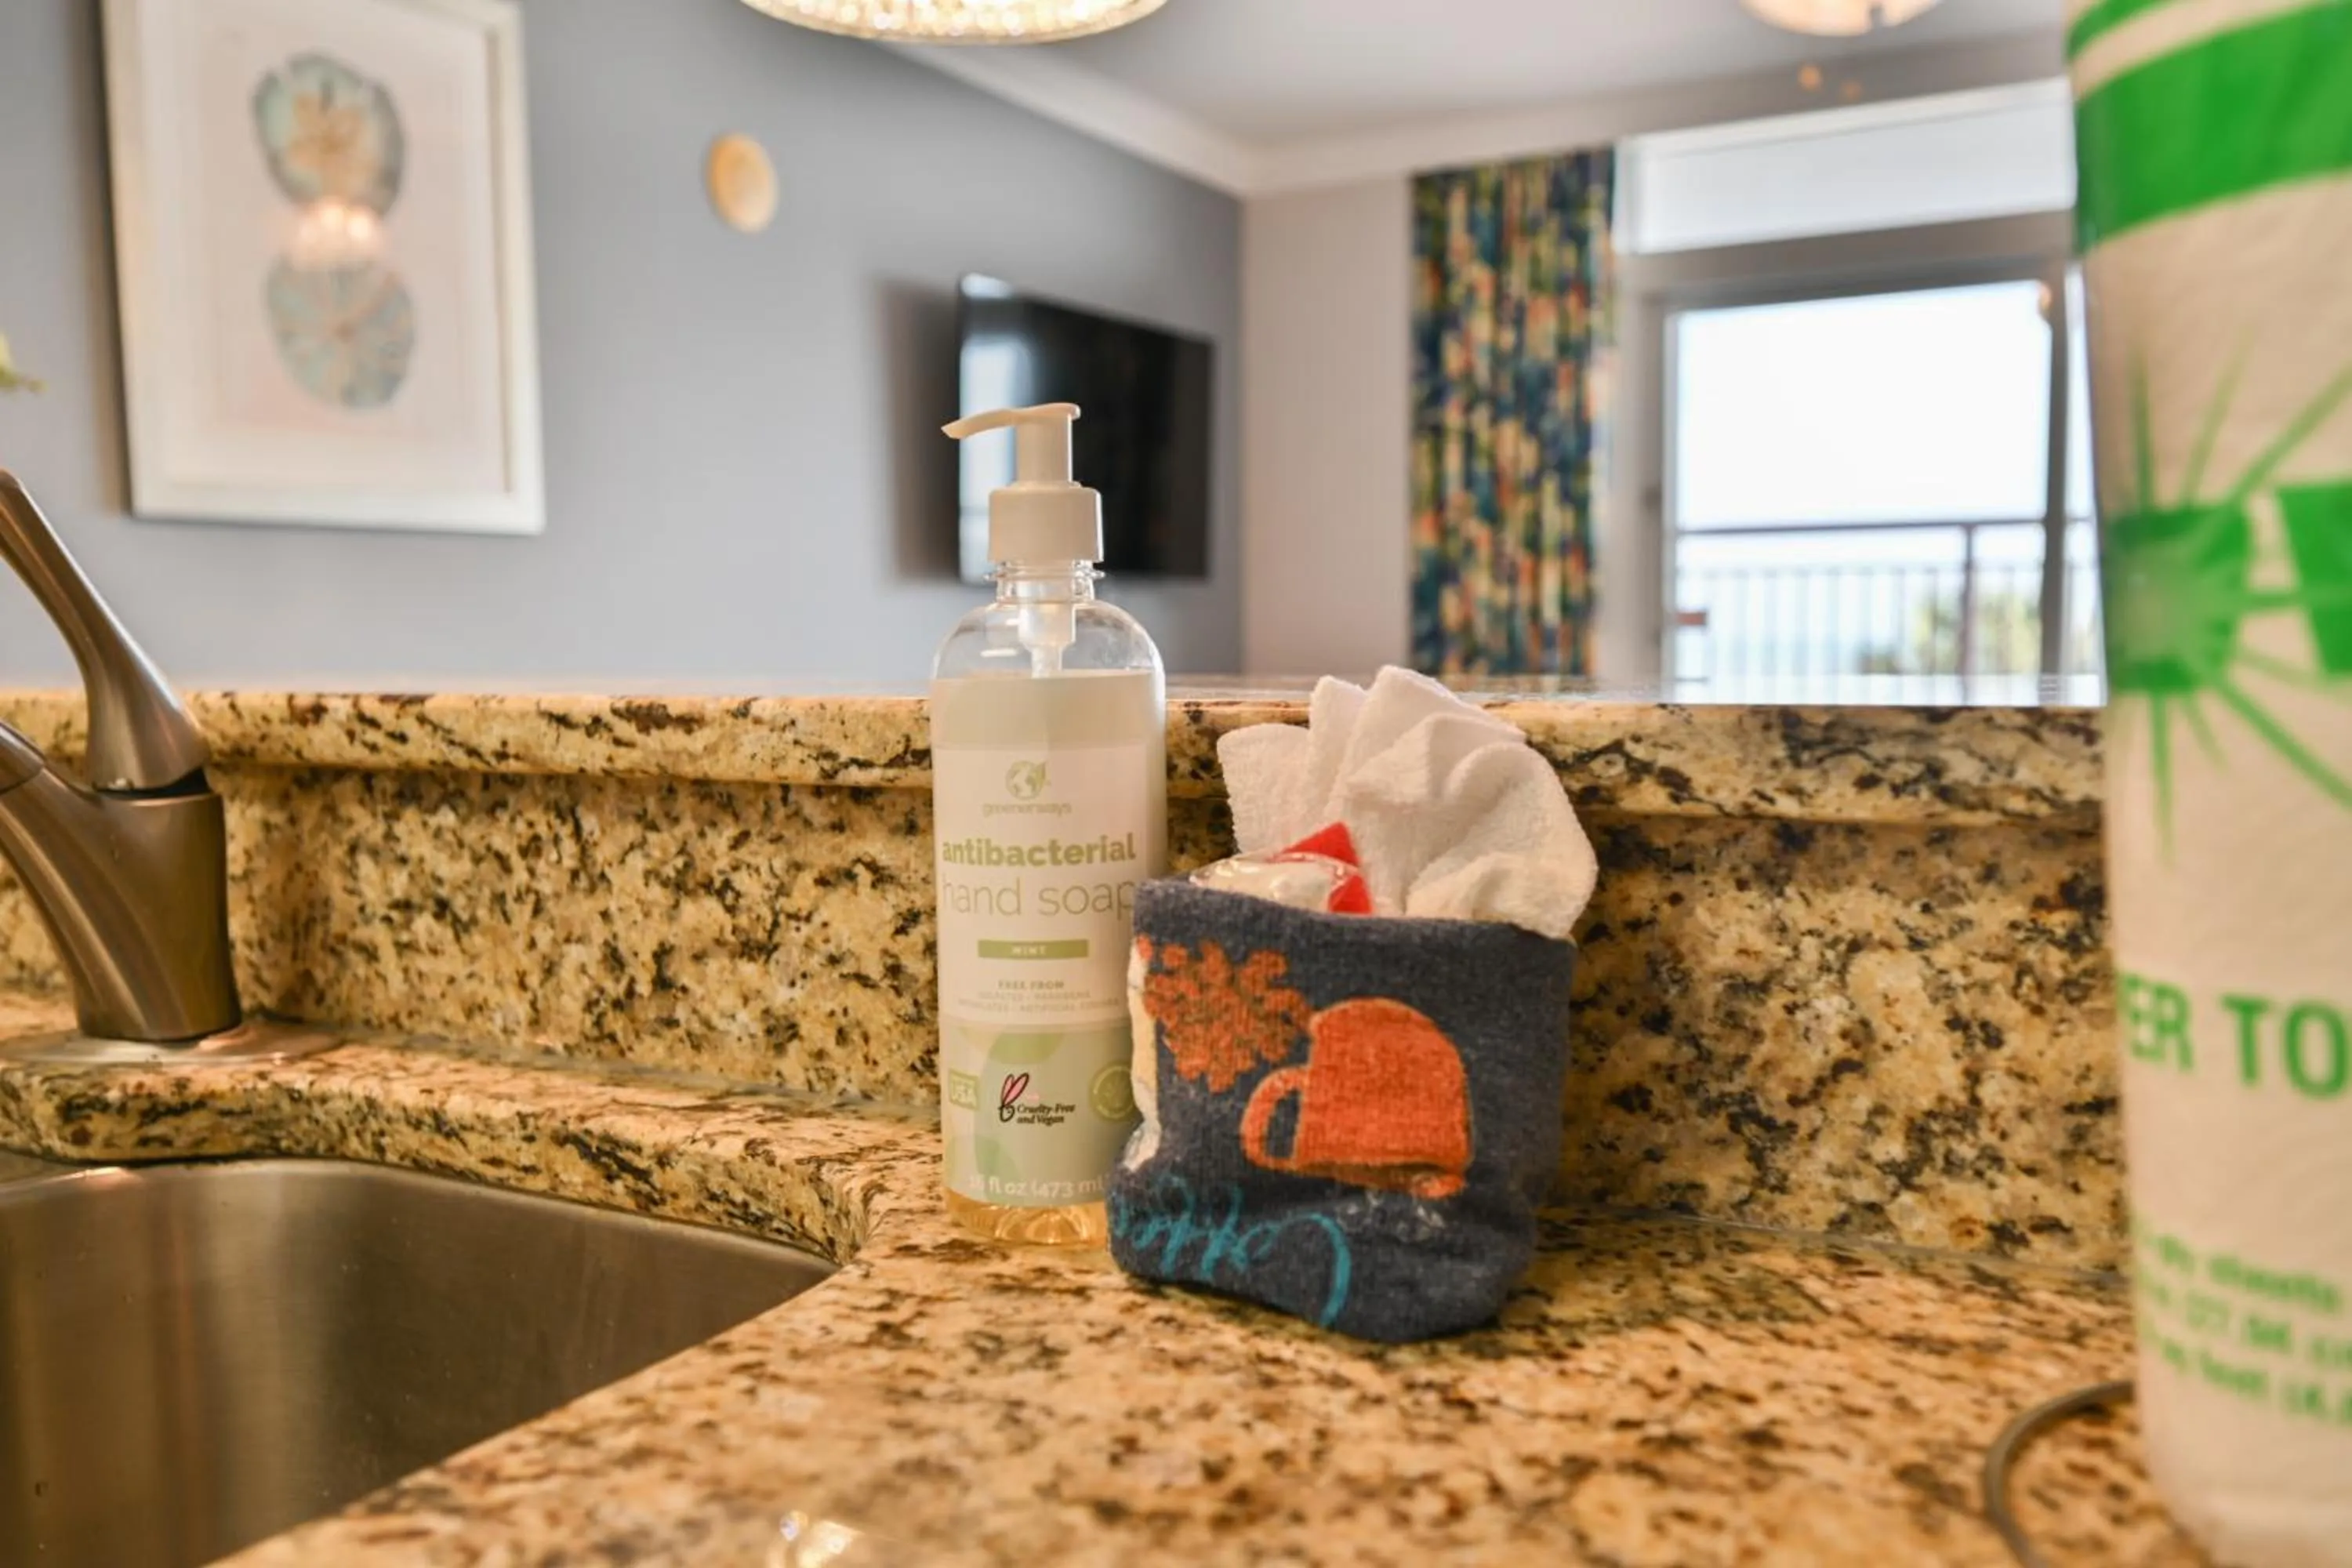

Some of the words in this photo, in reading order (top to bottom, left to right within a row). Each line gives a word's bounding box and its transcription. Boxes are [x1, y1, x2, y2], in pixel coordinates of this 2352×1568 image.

[942, 833, 1137, 867] antibacterial
[941, 873, 1022, 916] hand
[1037, 880, 1137, 921] soap
[1011, 946, 1047, 955] MINT
[1017, 1103, 1076, 1115] Cruelty-Free
[1017, 1114, 1035, 1124] and
[1036, 1114, 1065, 1127] Vegan
[1004, 1181, 1025, 1197] oz
